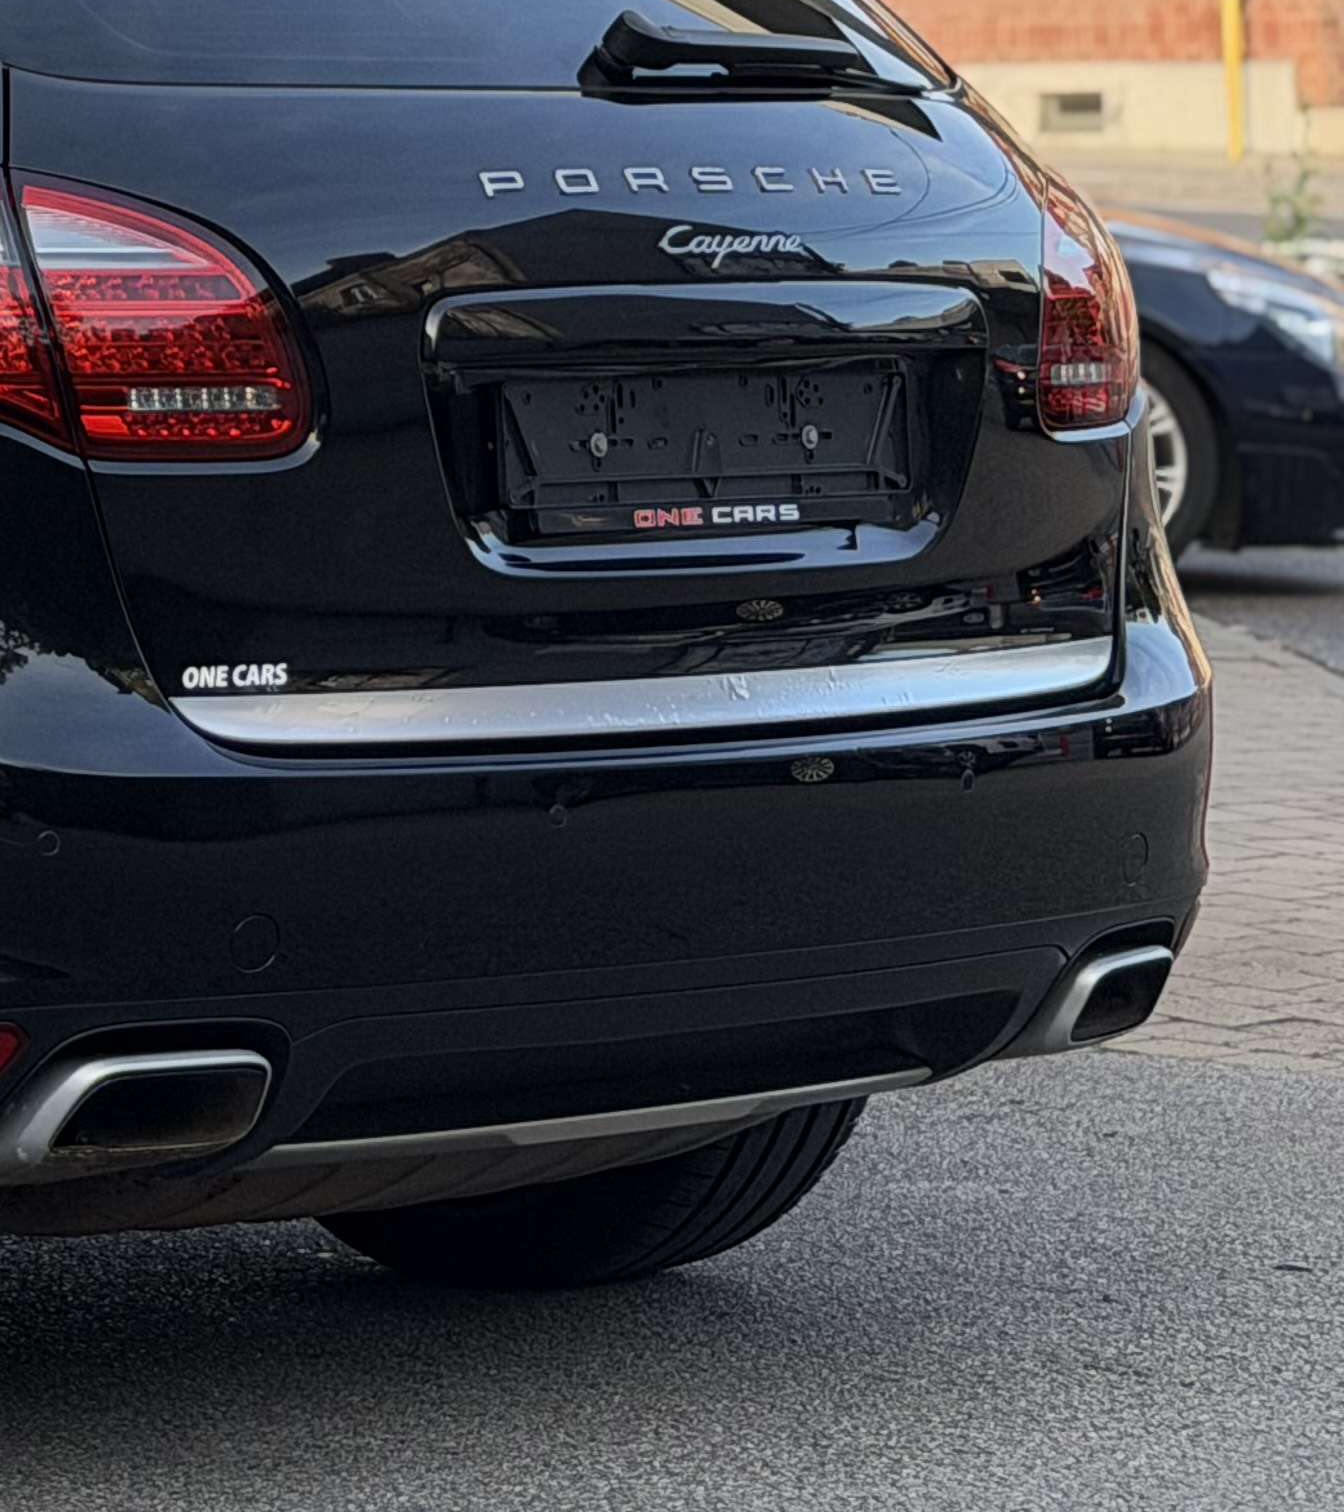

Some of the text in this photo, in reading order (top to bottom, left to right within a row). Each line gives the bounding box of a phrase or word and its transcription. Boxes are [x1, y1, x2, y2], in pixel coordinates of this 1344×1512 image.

[478, 166, 902, 198] PORSCHE
[657, 225, 808, 268] Cayenne
[633, 503, 800, 528] ONE CARS
[181, 662, 288, 689] ONE CARS
